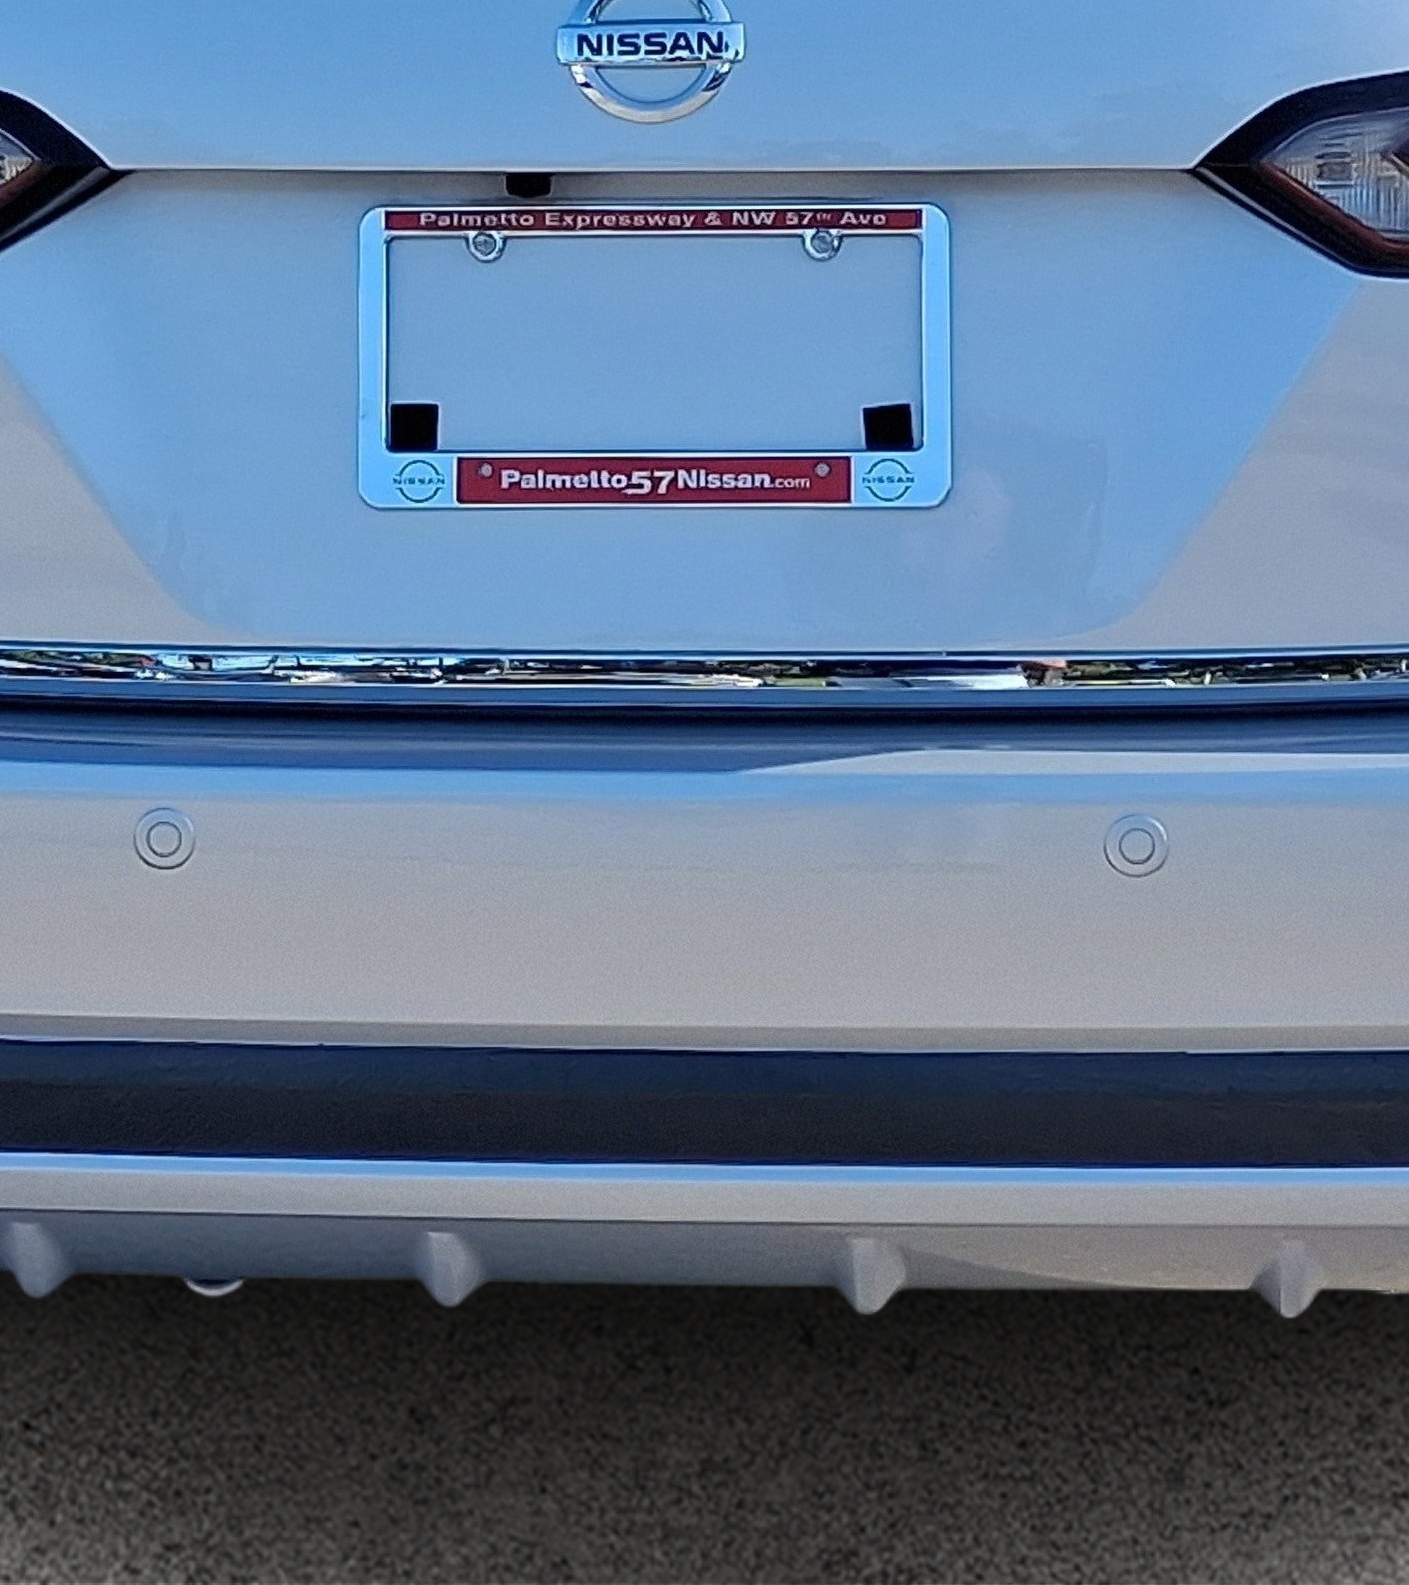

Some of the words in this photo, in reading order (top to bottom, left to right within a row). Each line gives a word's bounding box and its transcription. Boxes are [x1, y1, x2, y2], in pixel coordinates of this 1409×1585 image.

[576, 30, 724, 57] NISSAN
[418, 211, 535, 228] Palmetto
[544, 211, 695, 231] Expressway
[704, 211, 723, 227] &
[731, 211, 777, 226] NW
[839, 210, 888, 226] Ave
[861, 475, 915, 485] NISSAN
